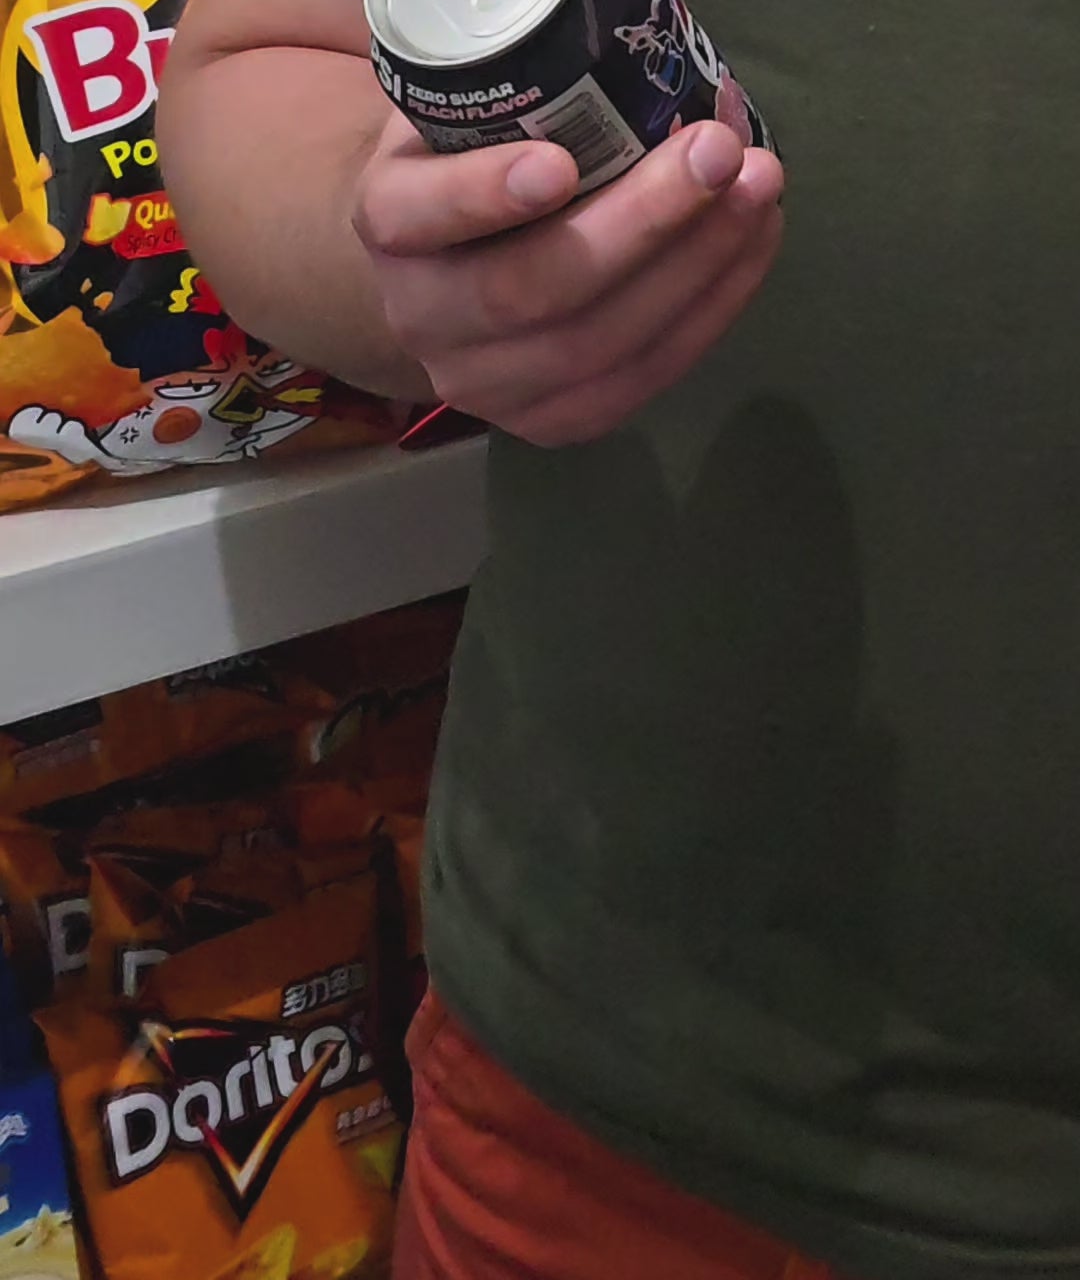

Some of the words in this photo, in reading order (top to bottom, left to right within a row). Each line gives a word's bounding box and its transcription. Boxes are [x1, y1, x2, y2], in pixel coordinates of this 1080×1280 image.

[406, 82, 446, 107] ZERO
[449, 81, 516, 107] SUGAR
[407, 98, 465, 121] PEACH
[467, 85, 545, 121] FLAVOR
